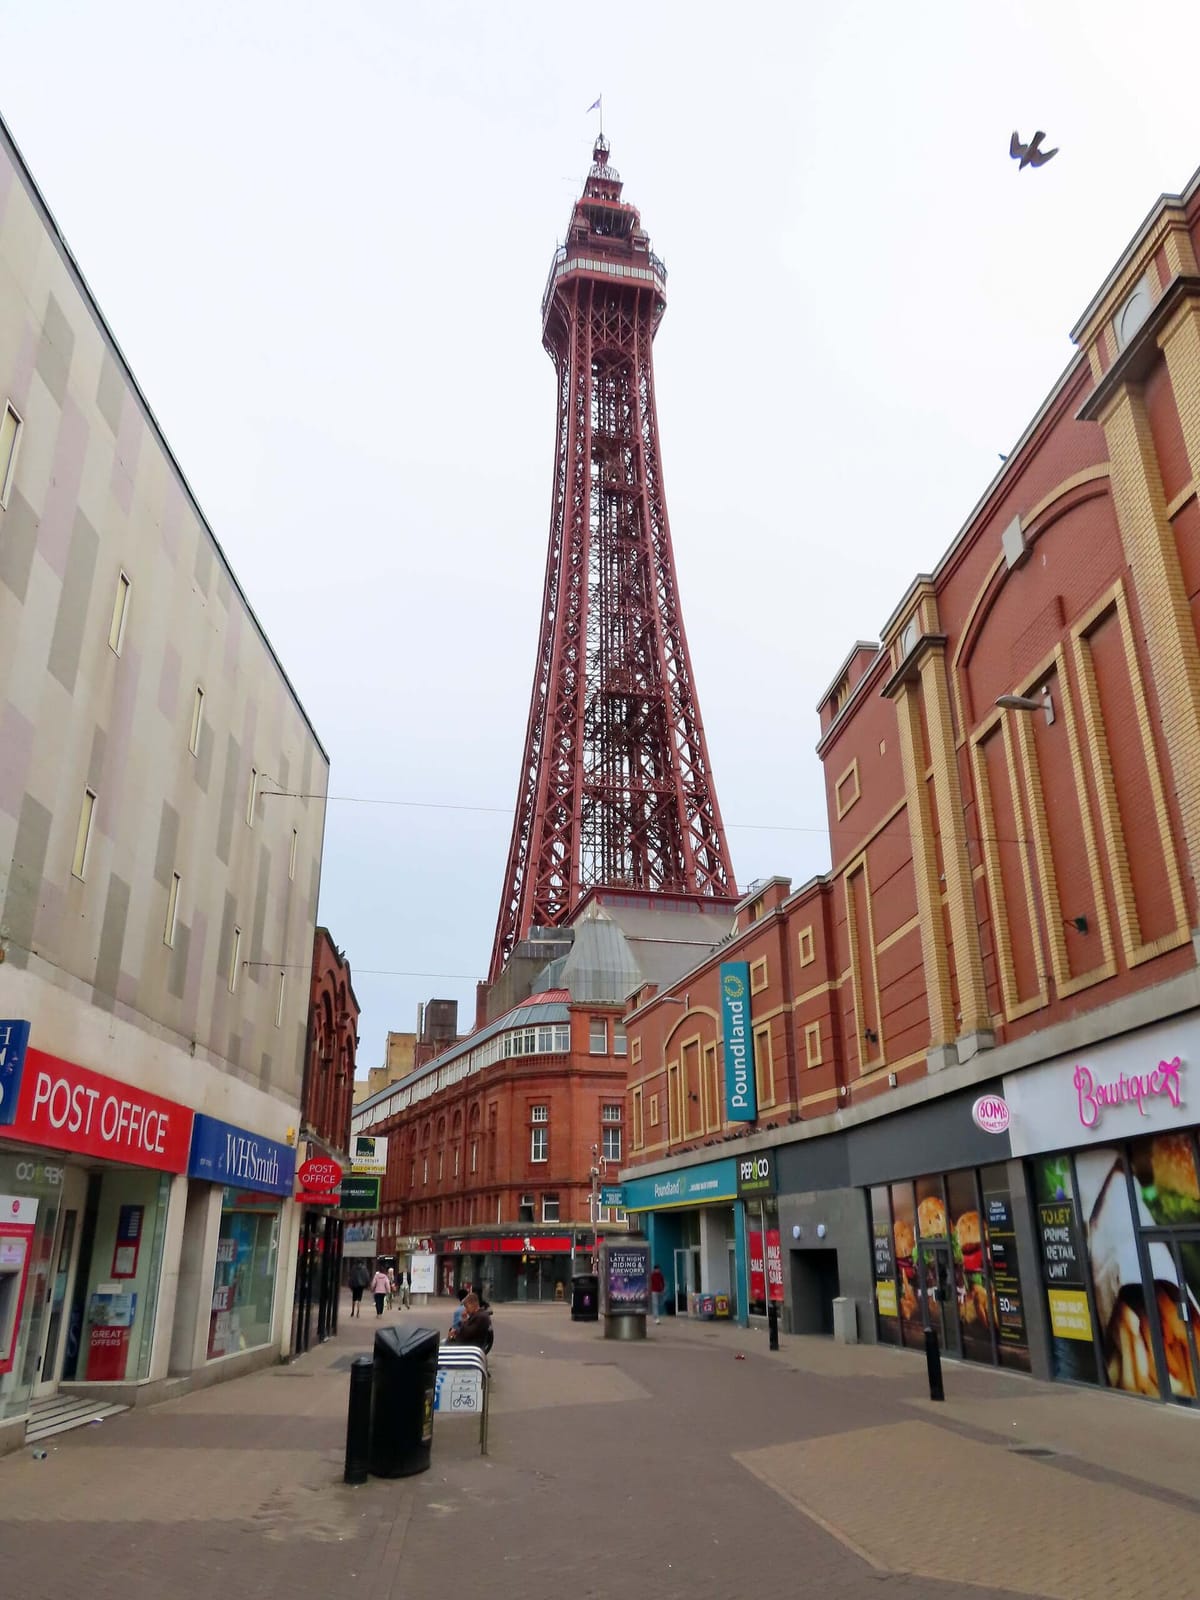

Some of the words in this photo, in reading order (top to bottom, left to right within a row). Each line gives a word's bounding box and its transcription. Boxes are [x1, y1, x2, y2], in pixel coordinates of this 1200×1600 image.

[728, 1001, 748, 1107] Poundland
[31, 1072, 100, 1135] POST
[101, 1095, 169, 1154] OFFICE
[226, 1133, 279, 1185] WHSmith
[309, 1164, 334, 1174] POST
[302, 1174, 336, 1184] OFFICE
[654, 1180, 681, 1197] Poundland
[1044, 1227, 1069, 1242] PRIME
[767, 1246, 780, 1259] HALF
[1046, 1245, 1076, 1261] RETAIL
[751, 1259, 764, 1273] SALE
[768, 1259, 781, 1271] PRICE
[1048, 1263, 1068, 1278] UNIT
[769, 1271, 783, 1284] SALE
[92, 1330, 122, 1338] GREAT
[91, 1338, 121, 1346] OFFERS
